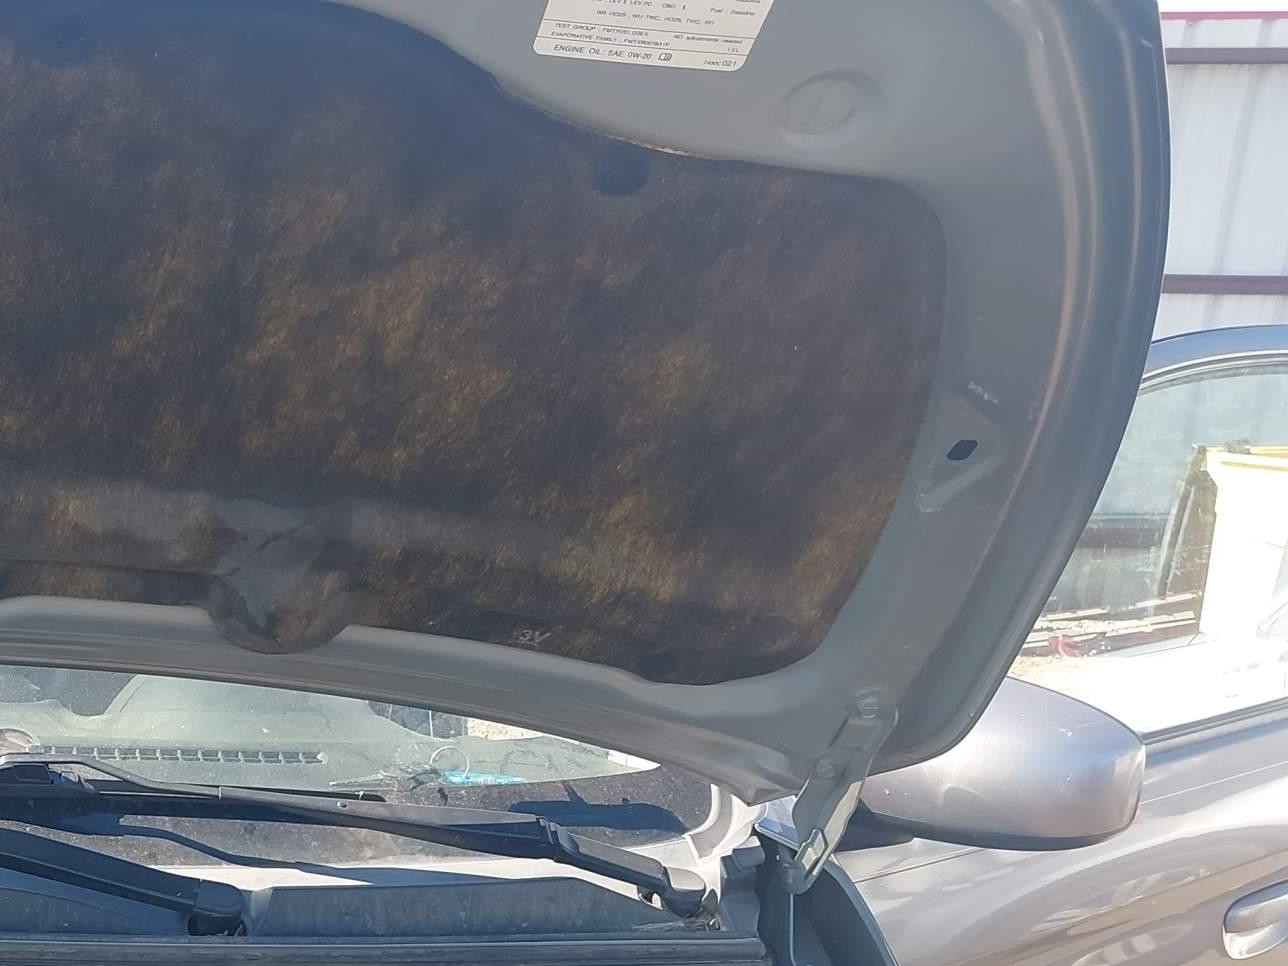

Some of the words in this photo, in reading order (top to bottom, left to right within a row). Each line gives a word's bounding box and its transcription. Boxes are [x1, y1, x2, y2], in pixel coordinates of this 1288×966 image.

[551, 31, 592, 41] EVAPORATIVE
[553, 44, 585, 54] ENGINE
[607, 49, 625, 57] SAE
[627, 51, 653, 60] 0W-20
